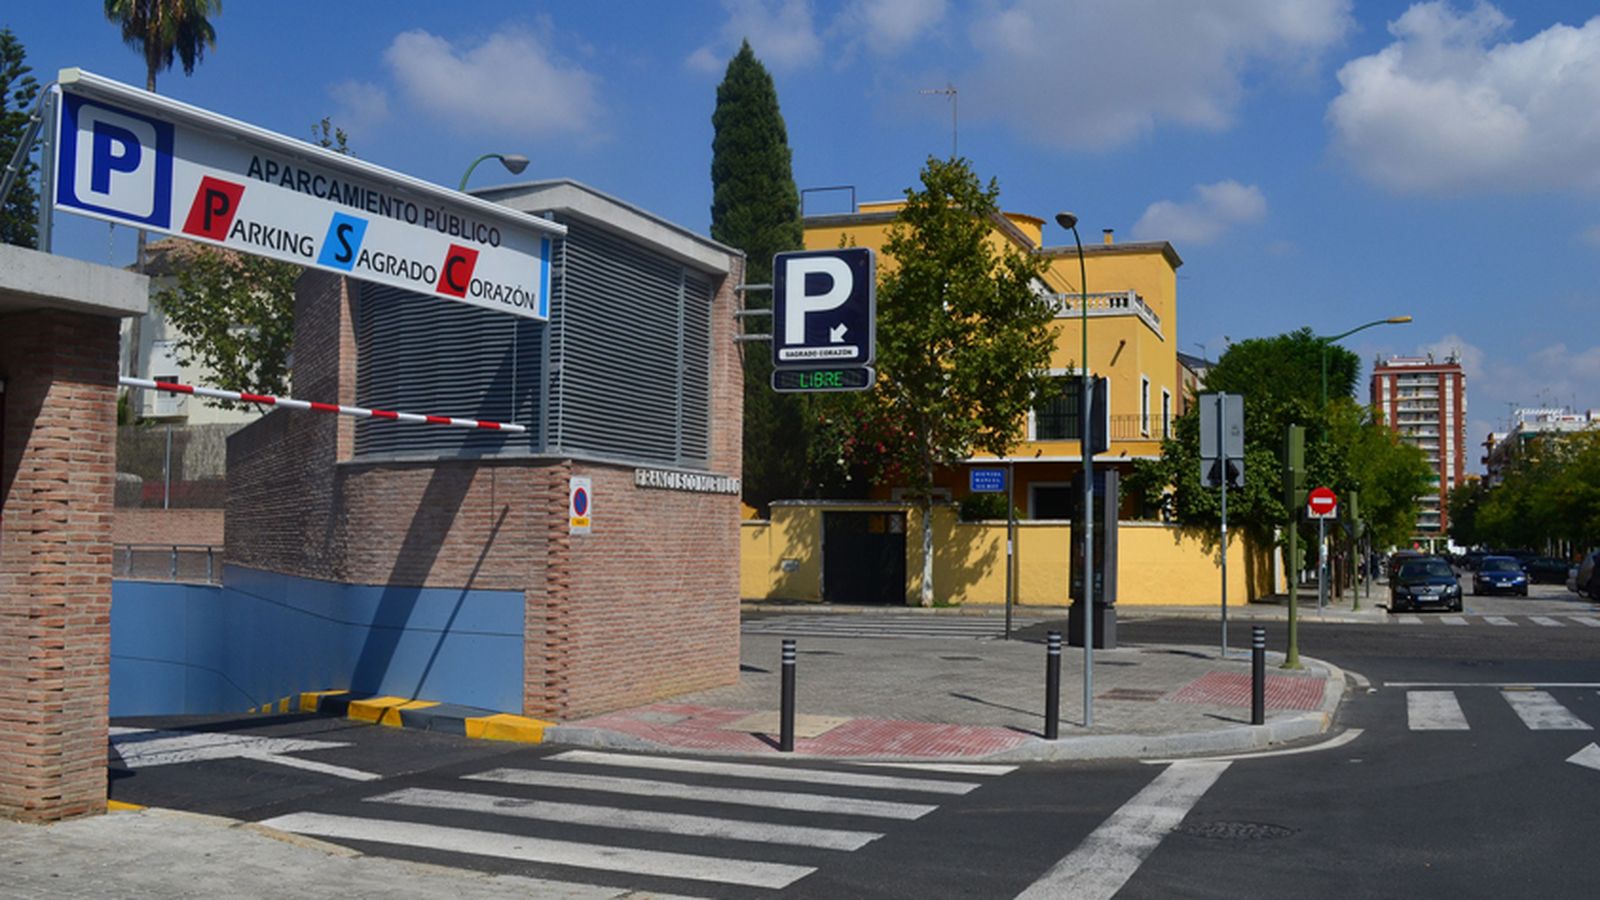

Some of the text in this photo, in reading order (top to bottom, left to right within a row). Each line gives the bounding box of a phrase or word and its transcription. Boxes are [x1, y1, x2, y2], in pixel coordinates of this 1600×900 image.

[91, 120, 142, 195] P
[247, 155, 501, 248] APARCAMIENTO PÚBLICO
[203, 188, 537, 310] PARKING SAGRADO CORAZÓN
[785, 256, 853, 345] P
[785, 350, 817, 358] SAGRADO
[799, 371, 843, 388] LIBRE
